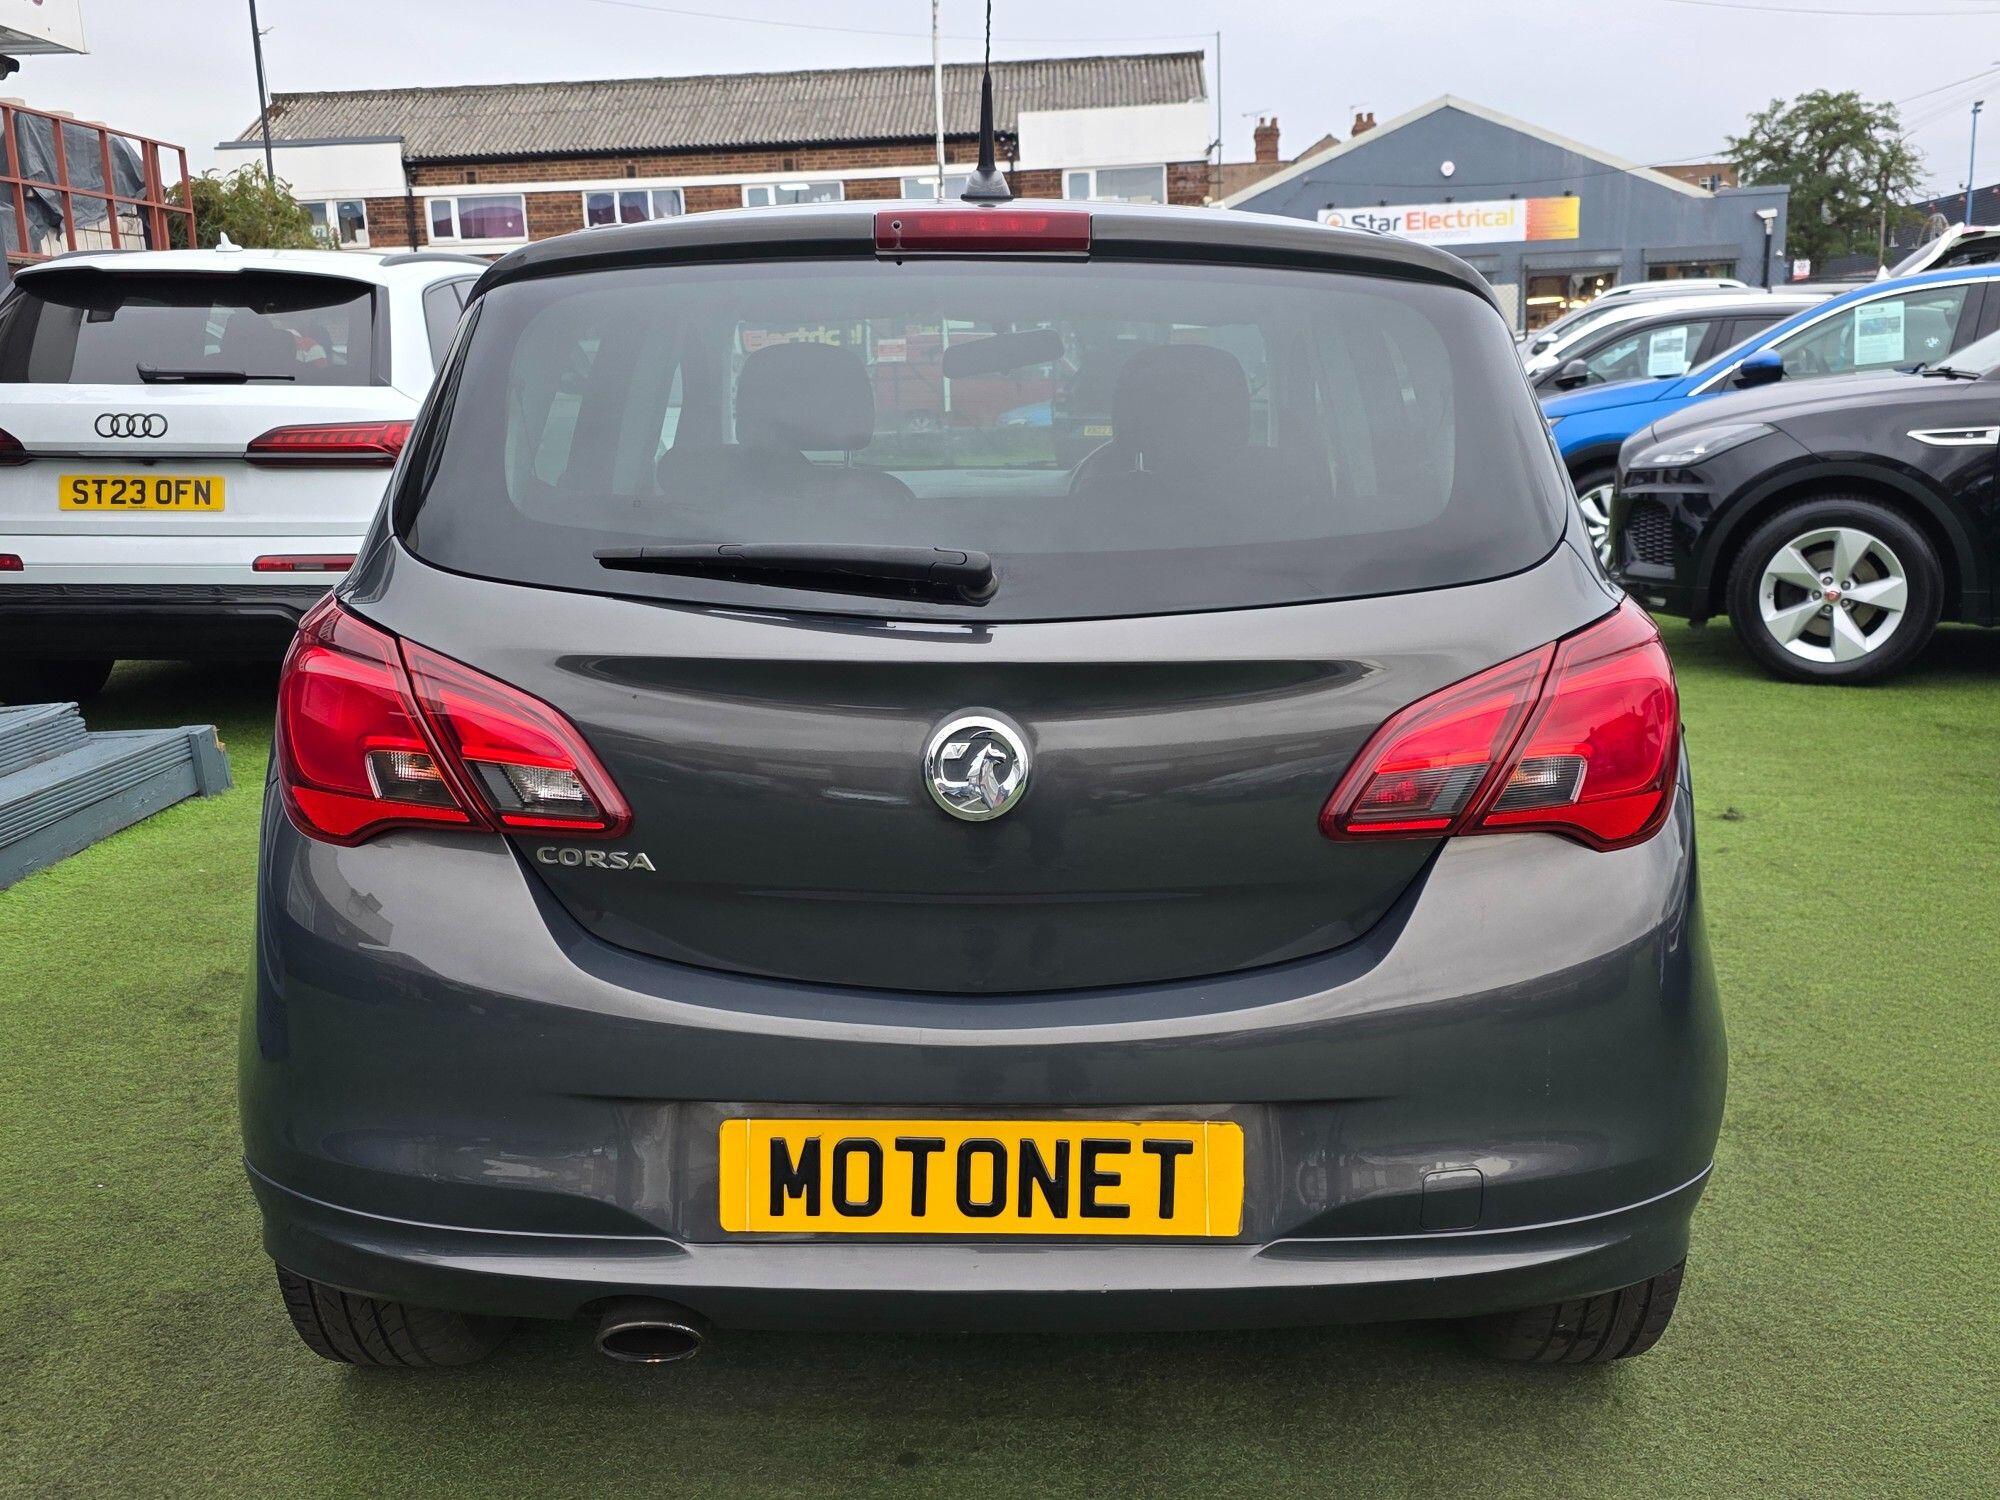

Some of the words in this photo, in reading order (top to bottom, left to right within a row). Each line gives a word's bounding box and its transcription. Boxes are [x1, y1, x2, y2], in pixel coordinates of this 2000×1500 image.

[1351, 214, 1402, 232] Star
[1405, 207, 1515, 231] Electrical
[72, 479, 146, 505] ST23
[155, 479, 211, 506] OFN
[536, 846, 657, 872] CORSA
[769, 1136, 1194, 1219] MOTONET
